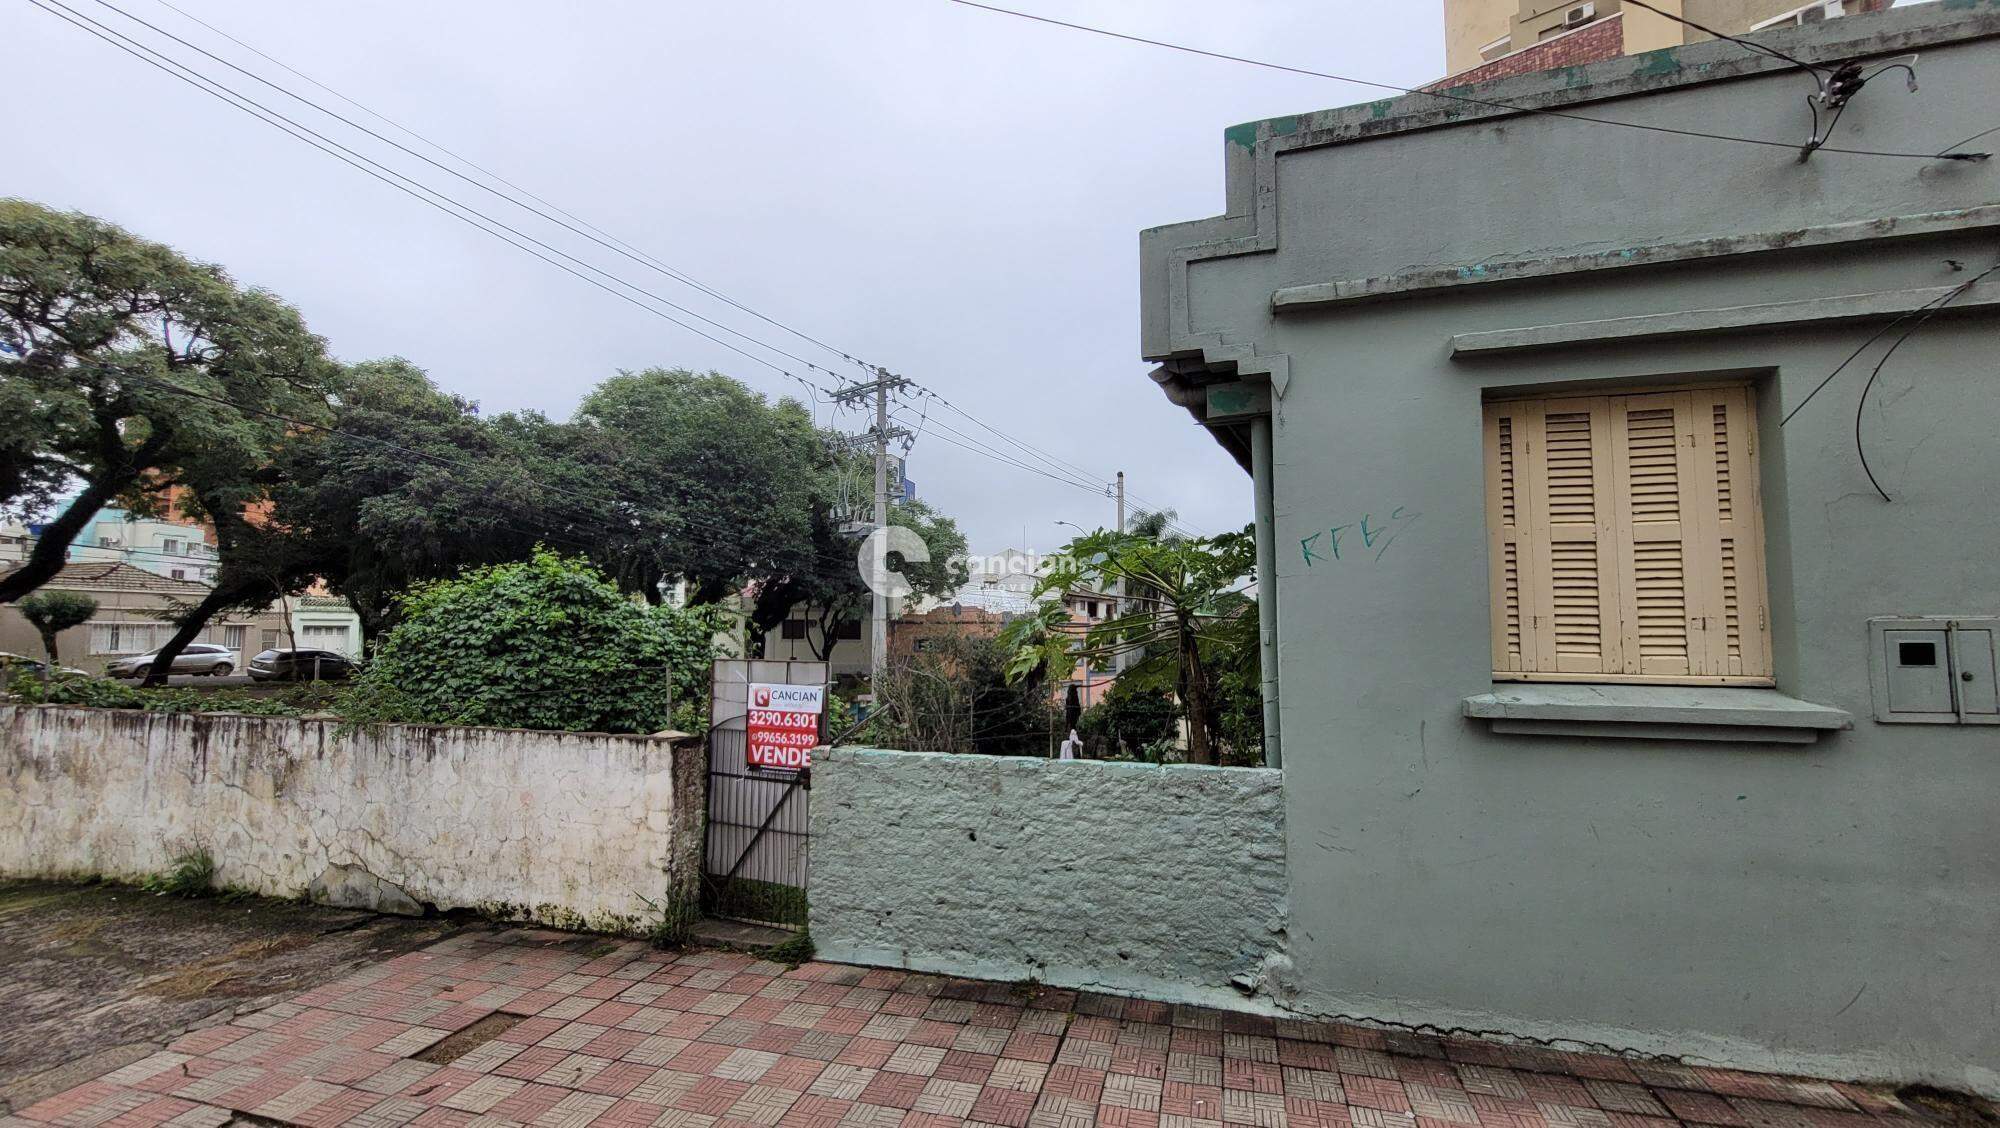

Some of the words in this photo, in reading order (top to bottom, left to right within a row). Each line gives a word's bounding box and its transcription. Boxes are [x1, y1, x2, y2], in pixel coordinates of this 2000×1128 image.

[771, 690, 818, 702] CANCIAN
[749, 711, 817, 728] 3290.6301
[757, 731, 815, 746] 99656.3199
[751, 745, 812, 767] VENDE
